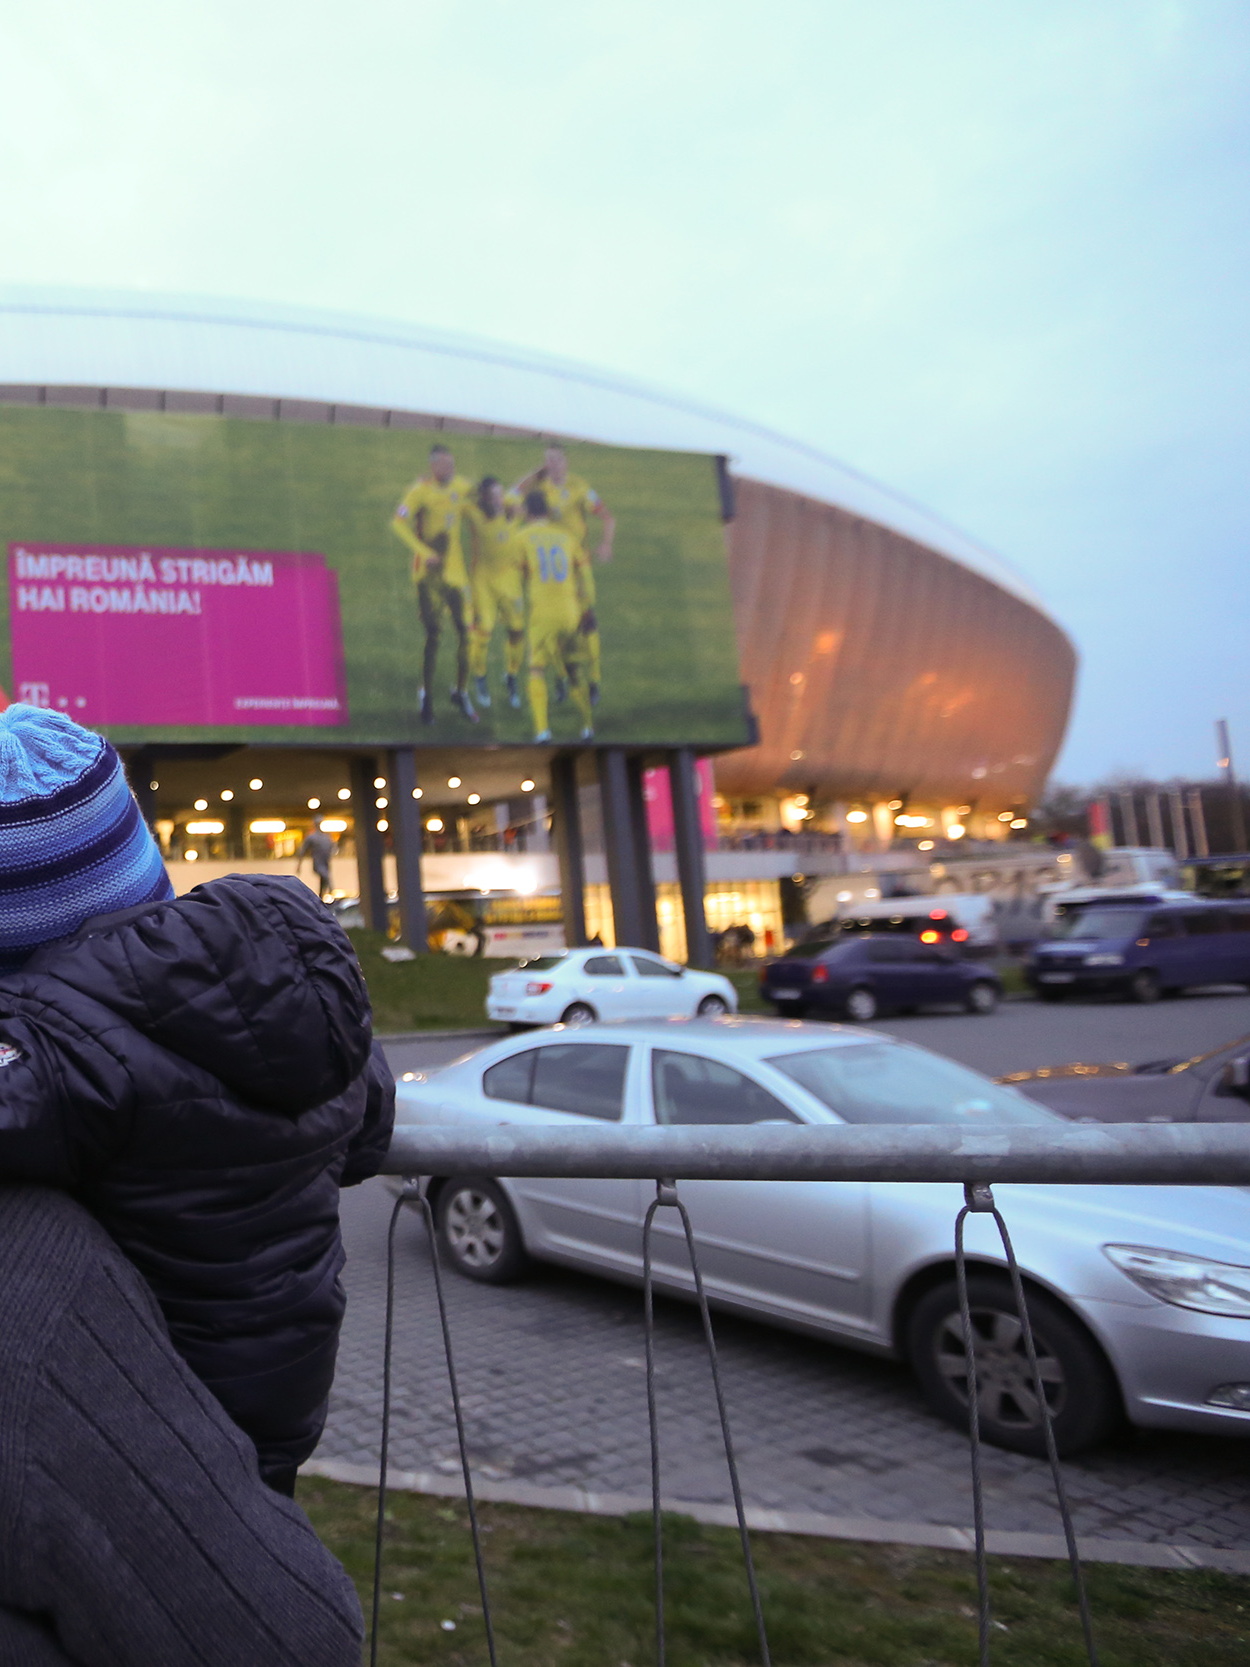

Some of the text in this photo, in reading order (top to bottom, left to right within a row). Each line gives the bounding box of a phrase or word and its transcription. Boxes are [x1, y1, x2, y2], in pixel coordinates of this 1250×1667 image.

[16, 548, 274, 587] ÎMPREUNĂ STRIGĂM
[536, 545, 568, 583] 10
[17, 582, 202, 615] HAI ROMÂNIA!
